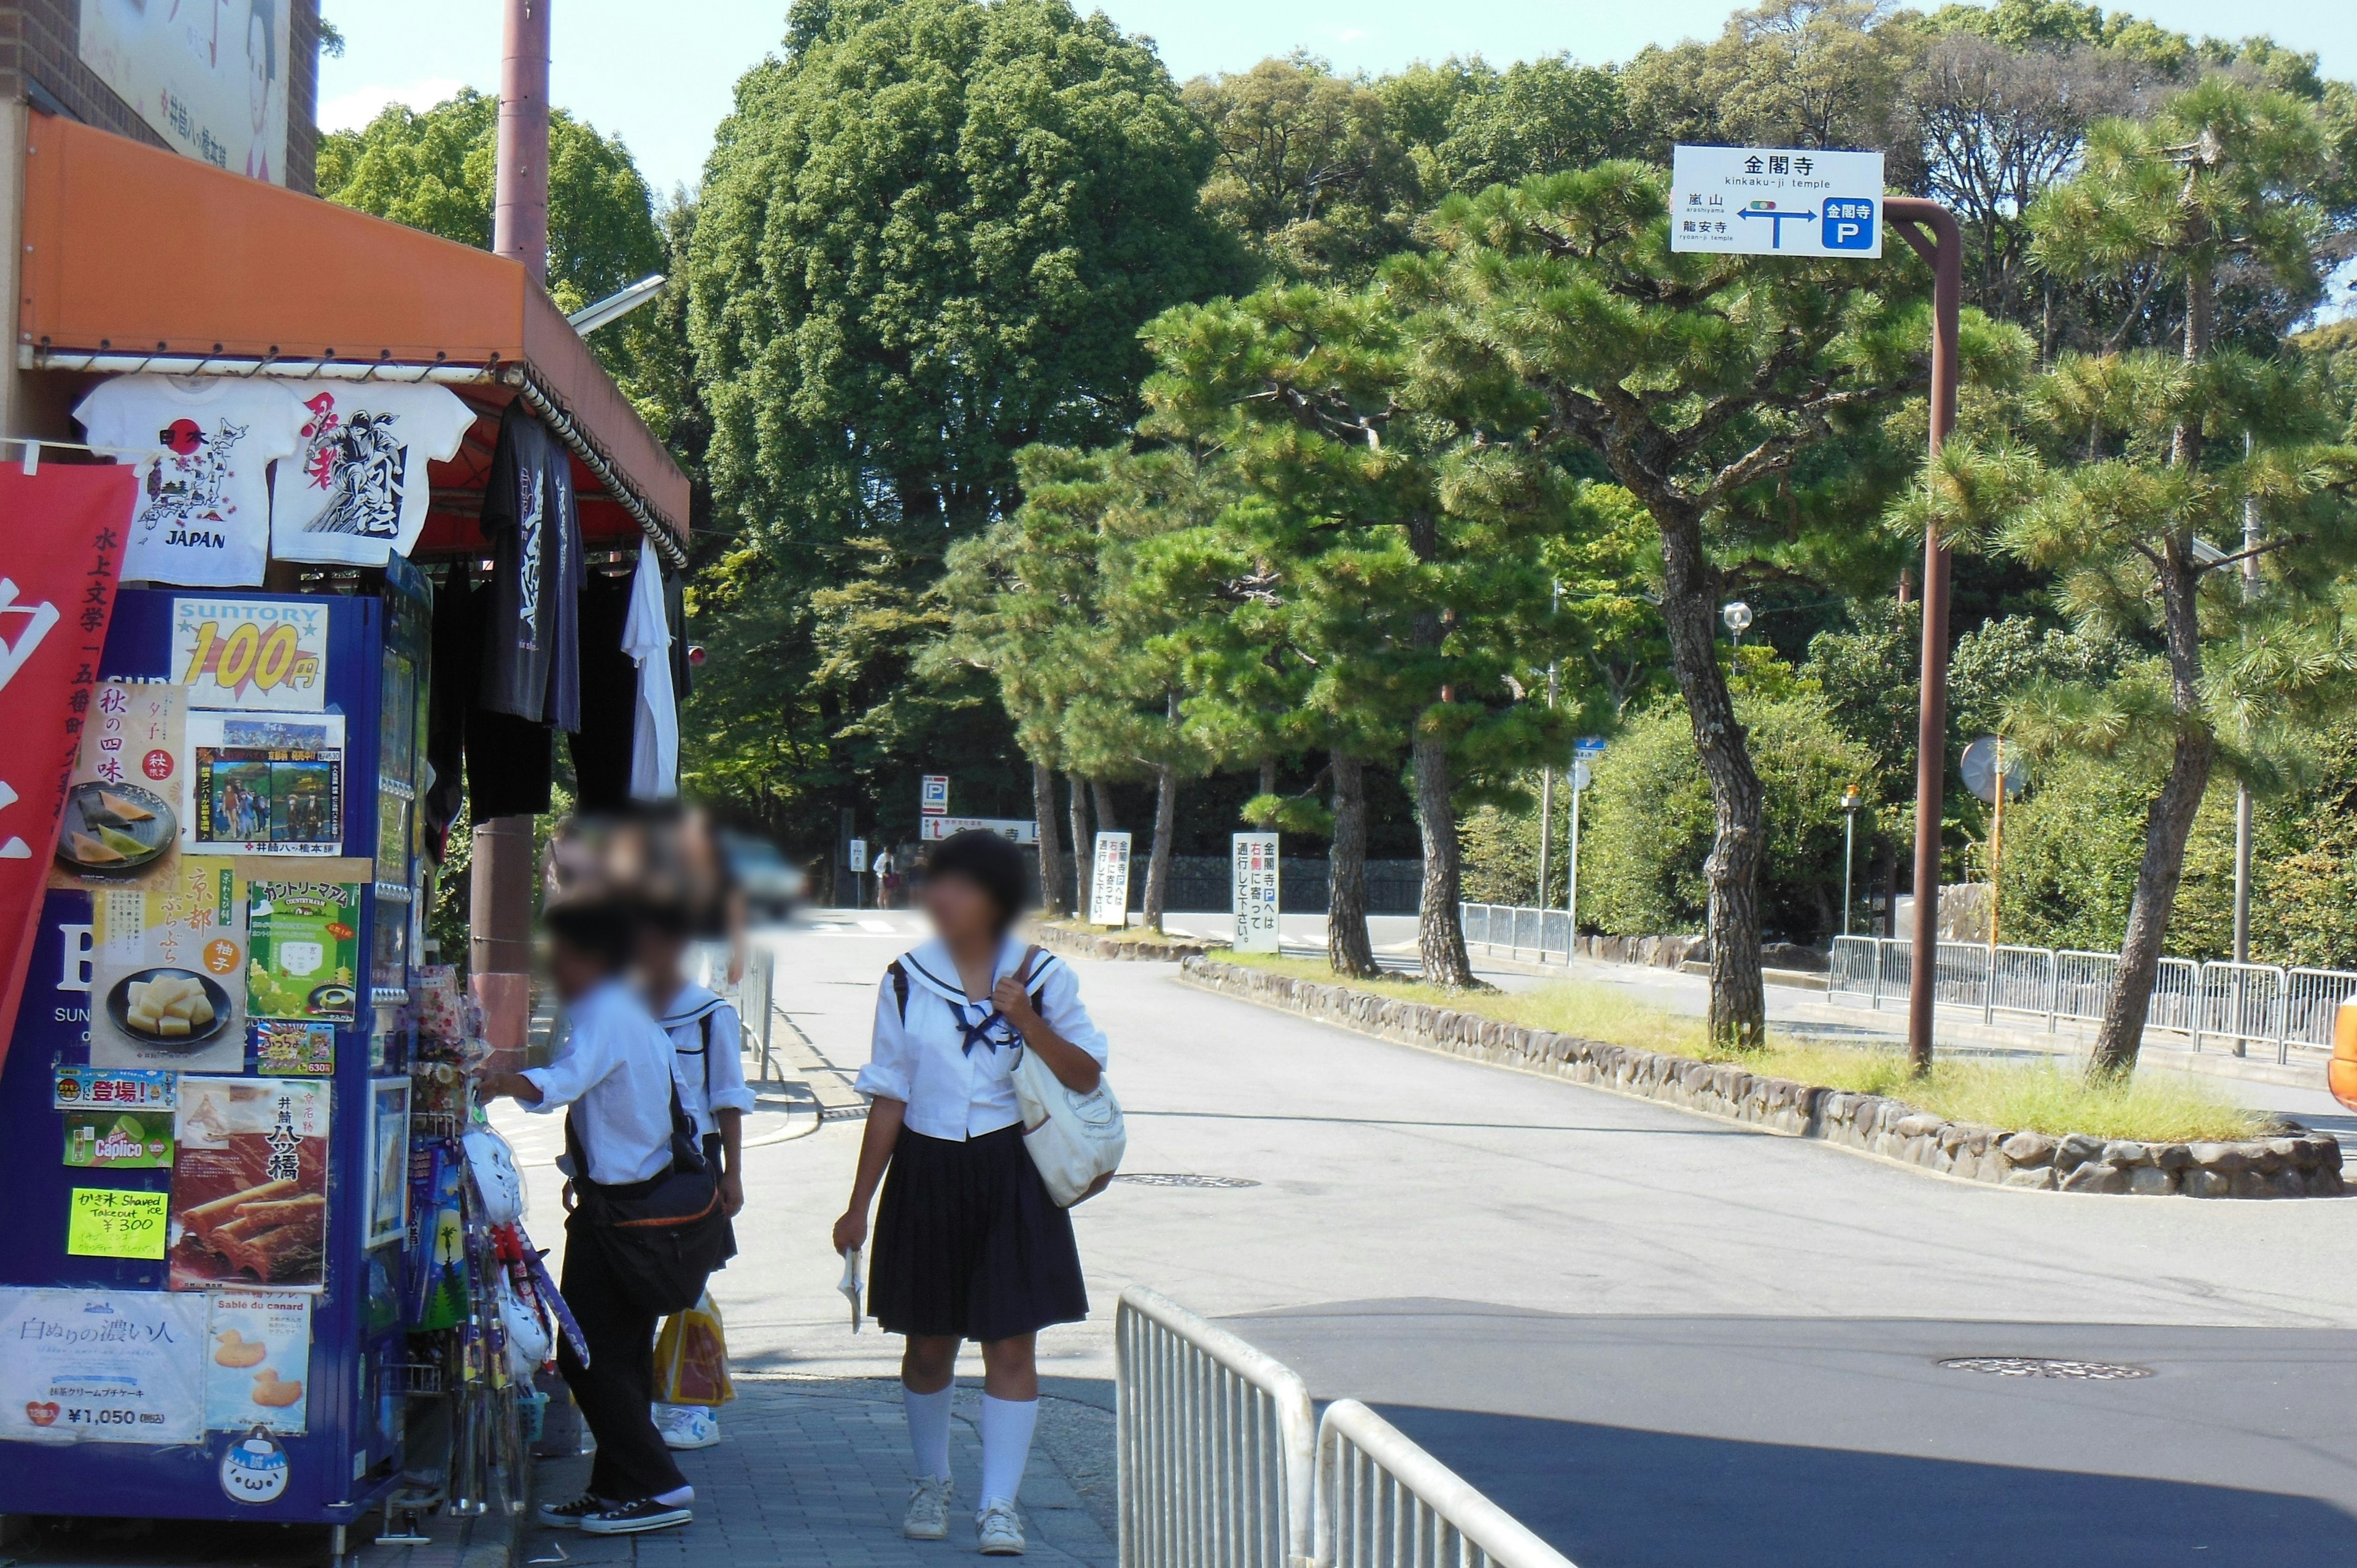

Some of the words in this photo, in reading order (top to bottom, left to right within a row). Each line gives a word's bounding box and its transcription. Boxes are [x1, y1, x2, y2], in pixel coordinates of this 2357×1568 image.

[1744, 155, 1815, 176] 金閣寺
[1725, 176, 1784, 188] kinkaku-ji
[1792, 179, 1830, 190] temple
[1827, 204, 1871, 220] 金閣寺
[1684, 220, 1727, 233] 龍安寺
[1837, 223, 1859, 244] P
[160, 429, 209, 445] 日本
[165, 530, 225, 549] JAPAN
[146, 701, 160, 740] 夕子
[98, 688, 126, 784] 秋の四味
[149, 754, 168, 767] 秋
[929, 785, 942, 798] P
[264, 881, 348, 908] カントリーマアム
[1251, 842, 1261, 929] 右側に寄って
[184, 868, 214, 938] 京都
[212, 942, 233, 971] 柚子
[92, 1081, 146, 1103] 登場!
[95, 1139, 143, 1161] Caplico
[79, 1192, 117, 1207] かき氷
[122, 1195, 161, 1206] Shaved
[90, 1208, 137, 1218] Takeout
[147, 1205, 164, 1215] ice
[267, 1302, 303, 1311] canard
[20, 1318, 174, 1344] 白ぬりの濃い人
[50, 1387, 144, 1398] 抹茶クリームプチケーキ
[68, 1409, 136, 1425] ¥1,050
